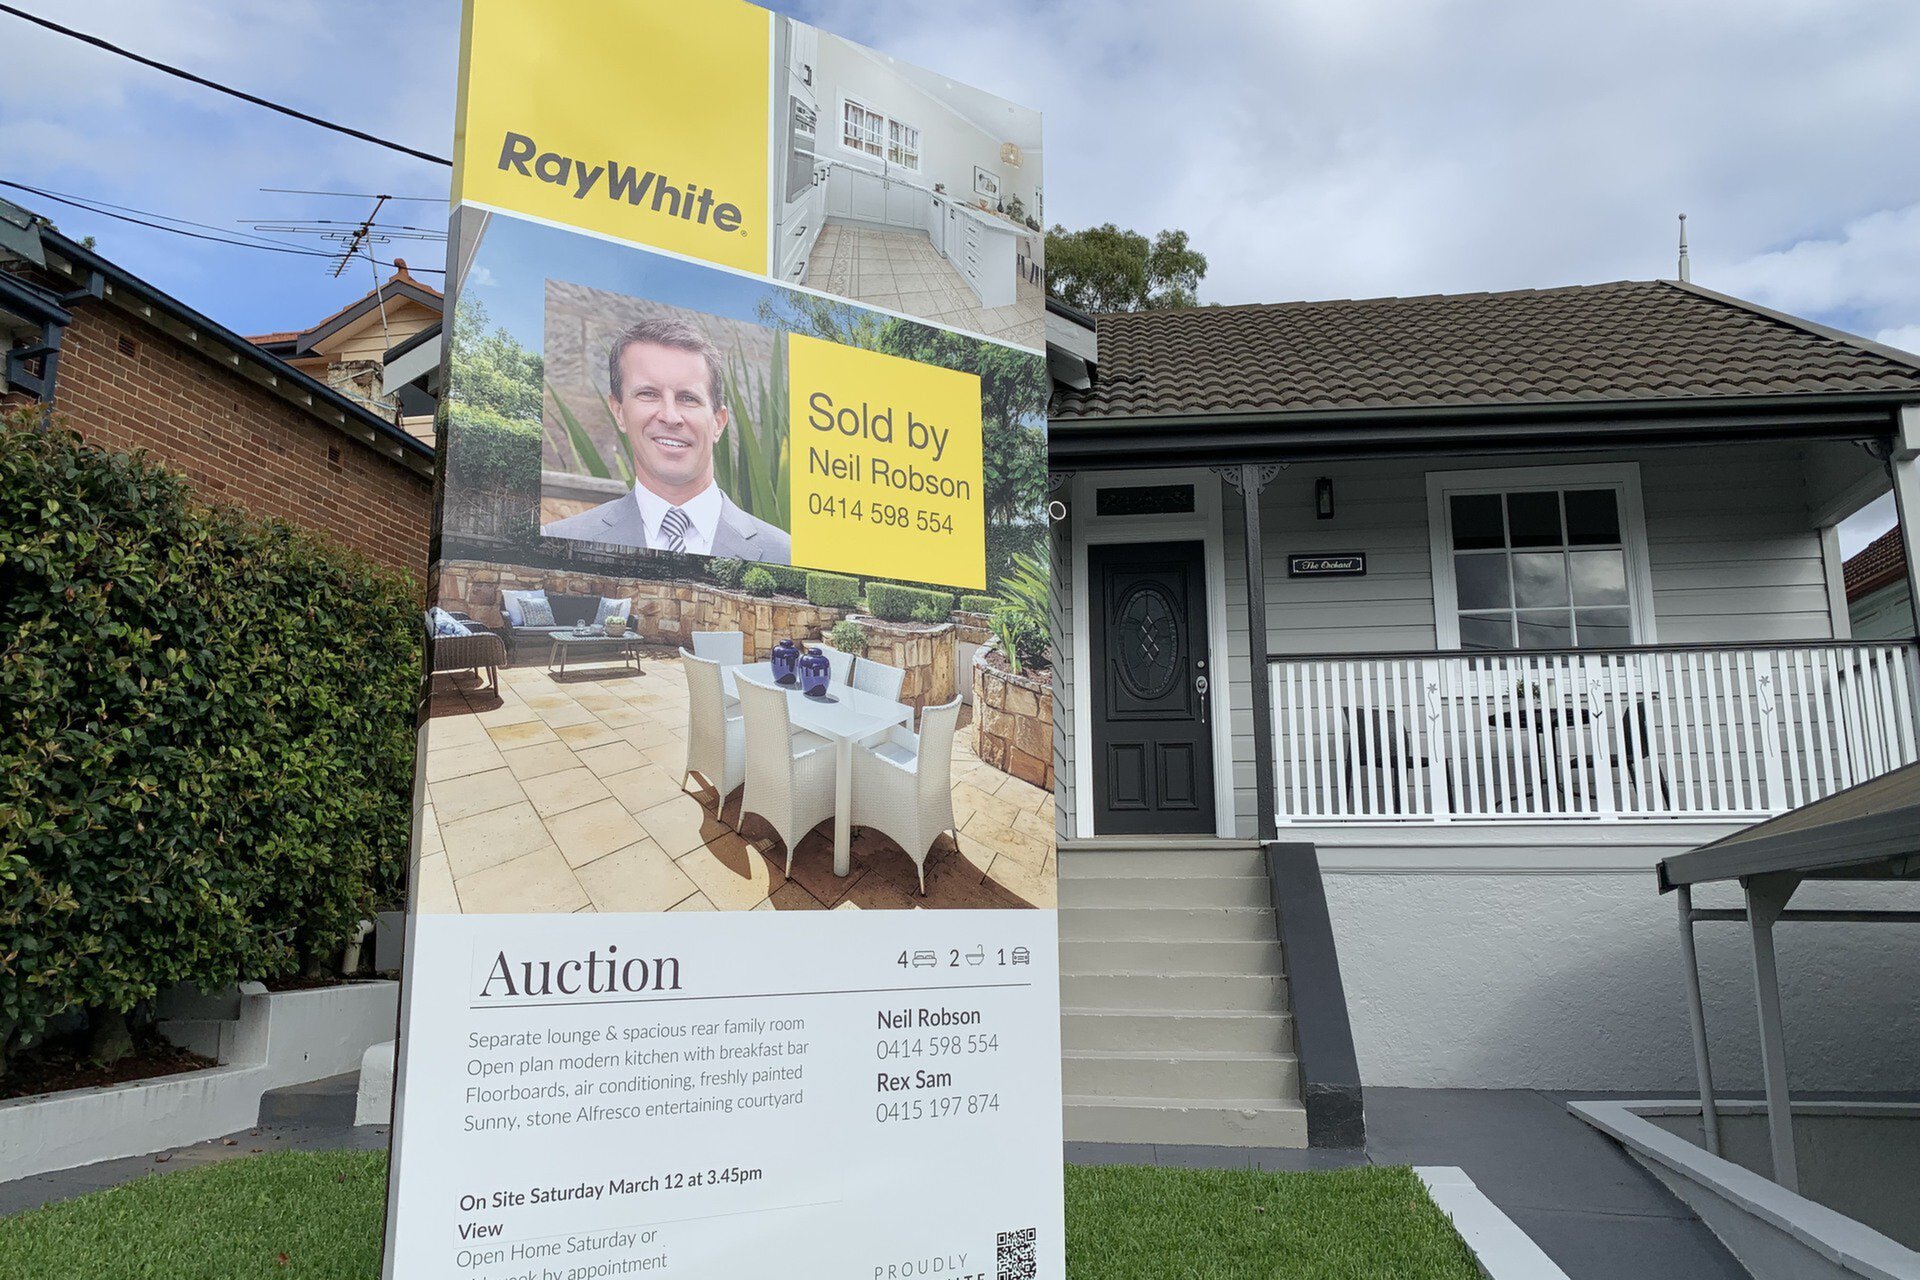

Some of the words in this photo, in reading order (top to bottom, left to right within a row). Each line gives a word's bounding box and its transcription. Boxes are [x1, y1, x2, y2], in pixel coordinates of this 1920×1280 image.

[809, 392, 893, 443] Sold
[908, 411, 950, 461] by
[809, 446, 860, 482] Neil
[872, 457, 970, 500] Robson
[809, 492, 863, 521] 0414
[870, 503, 909, 528] 598
[916, 510, 954, 534] 554
[1302, 560, 1319, 570] The
[1321, 560, 1353, 569] Orchard
[479, 944, 683, 997] Auction
[897, 950, 908, 968] 4
[949, 949, 960, 967] 2
[997, 948, 1006, 966] 1
[468, 1030, 542, 1050] Separate
[547, 1028, 601, 1046] lounge
[605, 1025, 618, 1041] &
[623, 1023, 687, 1042] spacious
[691, 1023, 720, 1036] rear
[724, 1018, 766, 1035] family
[769, 1018, 805, 1032] room
[877, 1008, 912, 1029] Neil
[918, 1007, 981, 1027] Robson
[467, 1059, 514, 1078] Open
[519, 1056, 553, 1076] plan
[559, 1053, 619, 1070] modern
[624, 1049, 679, 1066] kitchen
[684, 1045, 715, 1062] with
[719, 1042, 783, 1060] breakfast
[787, 1040, 809, 1055] bar
[876, 1038, 923, 1060] 0414
[929, 1035, 962, 1056] 598
[967, 1033, 999, 1054] 554
[466, 1081, 569, 1103] Floorboards,
[574, 1079, 594, 1096] air
[599, 1073, 695, 1095] conditioning,
[700, 1069, 748, 1086] freshly
[752, 1064, 803, 1085] painted
[877, 1072, 910, 1092] Rex
[915, 1069, 951, 1089] Sam
[464, 1115, 521, 1132] Sunny,
[526, 1111, 571, 1127] stone
[576, 1105, 641, 1123] Alfresco
[645, 1096, 733, 1117] entertaining
[737, 1089, 803, 1109] courtyard
[876, 1099, 923, 1123] 0415
[929, 1096, 962, 1118] 197
[967, 1093, 1000, 1114] 874
[460, 1194, 486, 1211] On
[492, 1192, 525, 1208] Site
[530, 1182, 604, 1204] Saturday
[609, 1176, 659, 1195] March
[664, 1173, 684, 1190] 12
[688, 1172, 703, 1187] at
[707, 1167, 762, 1185] 3.45pm
[458, 1223, 503, 1240] View
[456, 1250, 504, 1269] Open
[511, 1242, 561, 1261] Home
[567, 1230, 637, 1253] Saturday
[641, 1230, 658, 1244] or
[568, 1253, 668, 1280] appointment
[875, 1253, 968, 1280] PROUDLY
